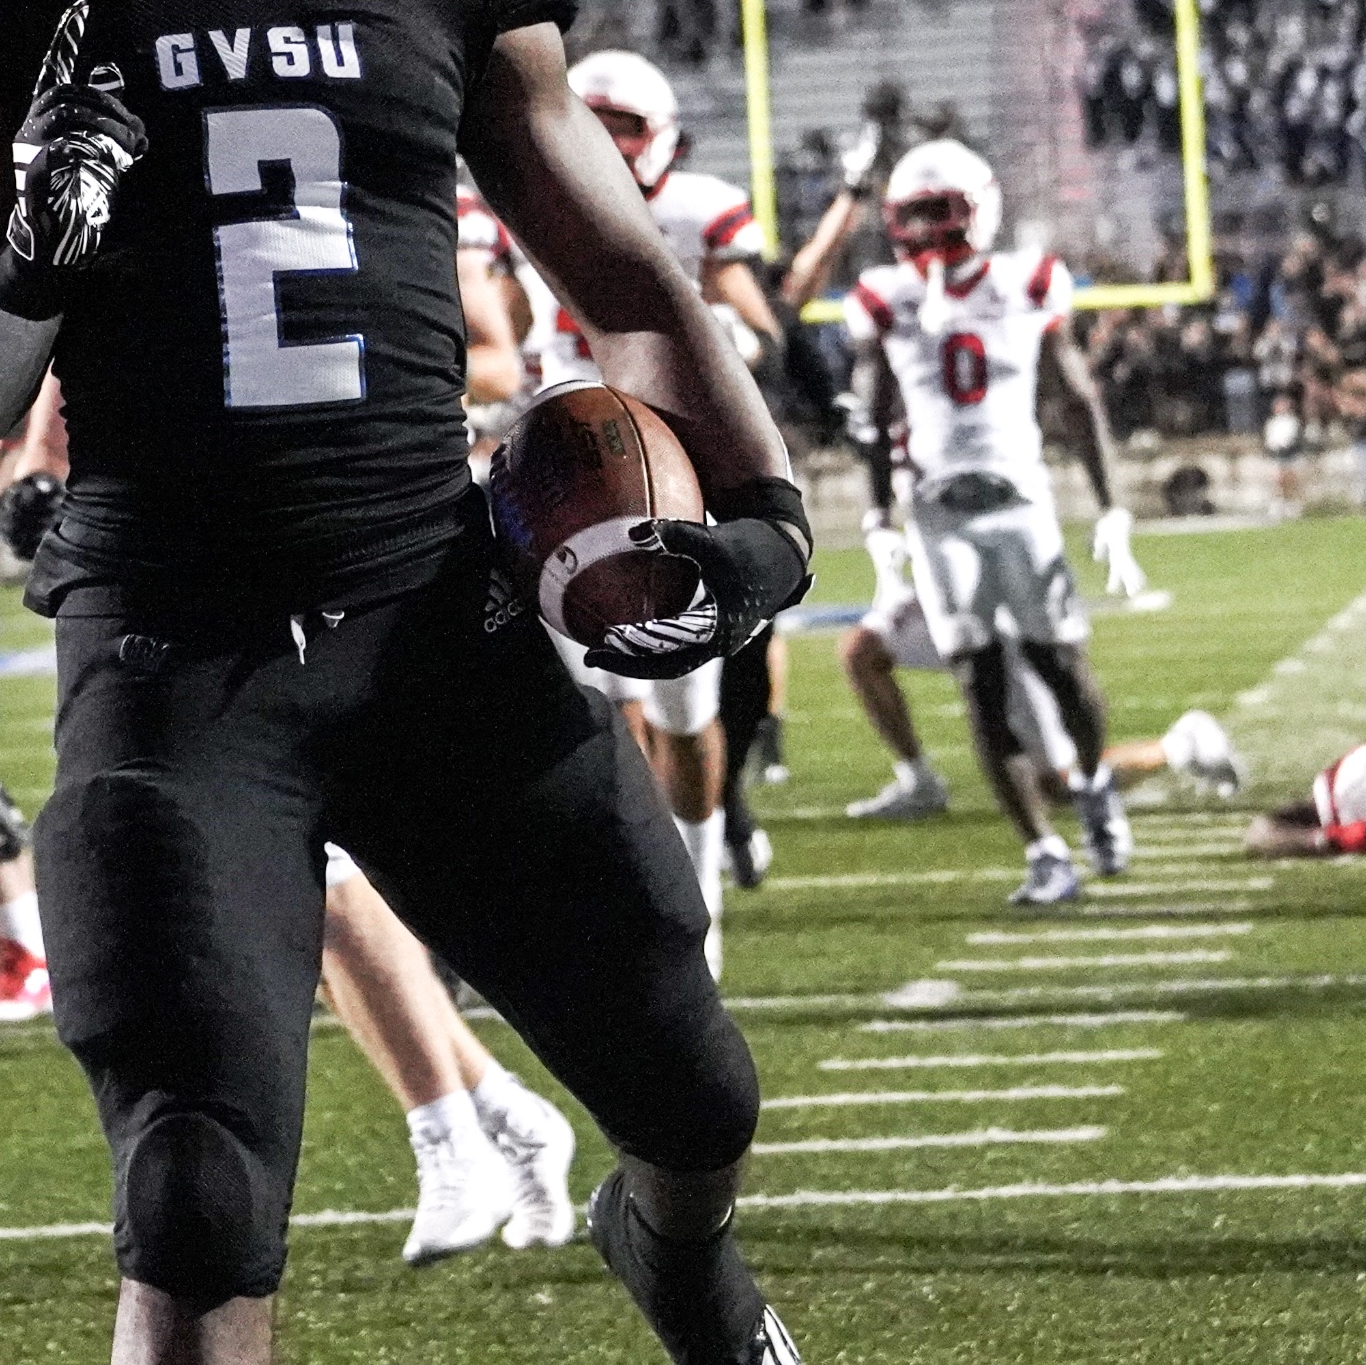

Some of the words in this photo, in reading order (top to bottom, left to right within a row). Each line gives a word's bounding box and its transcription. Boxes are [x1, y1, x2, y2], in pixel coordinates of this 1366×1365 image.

[155, 24, 363, 91] GVSU
[201, 102, 366, 409] 2
[940, 331, 988, 409] 0
